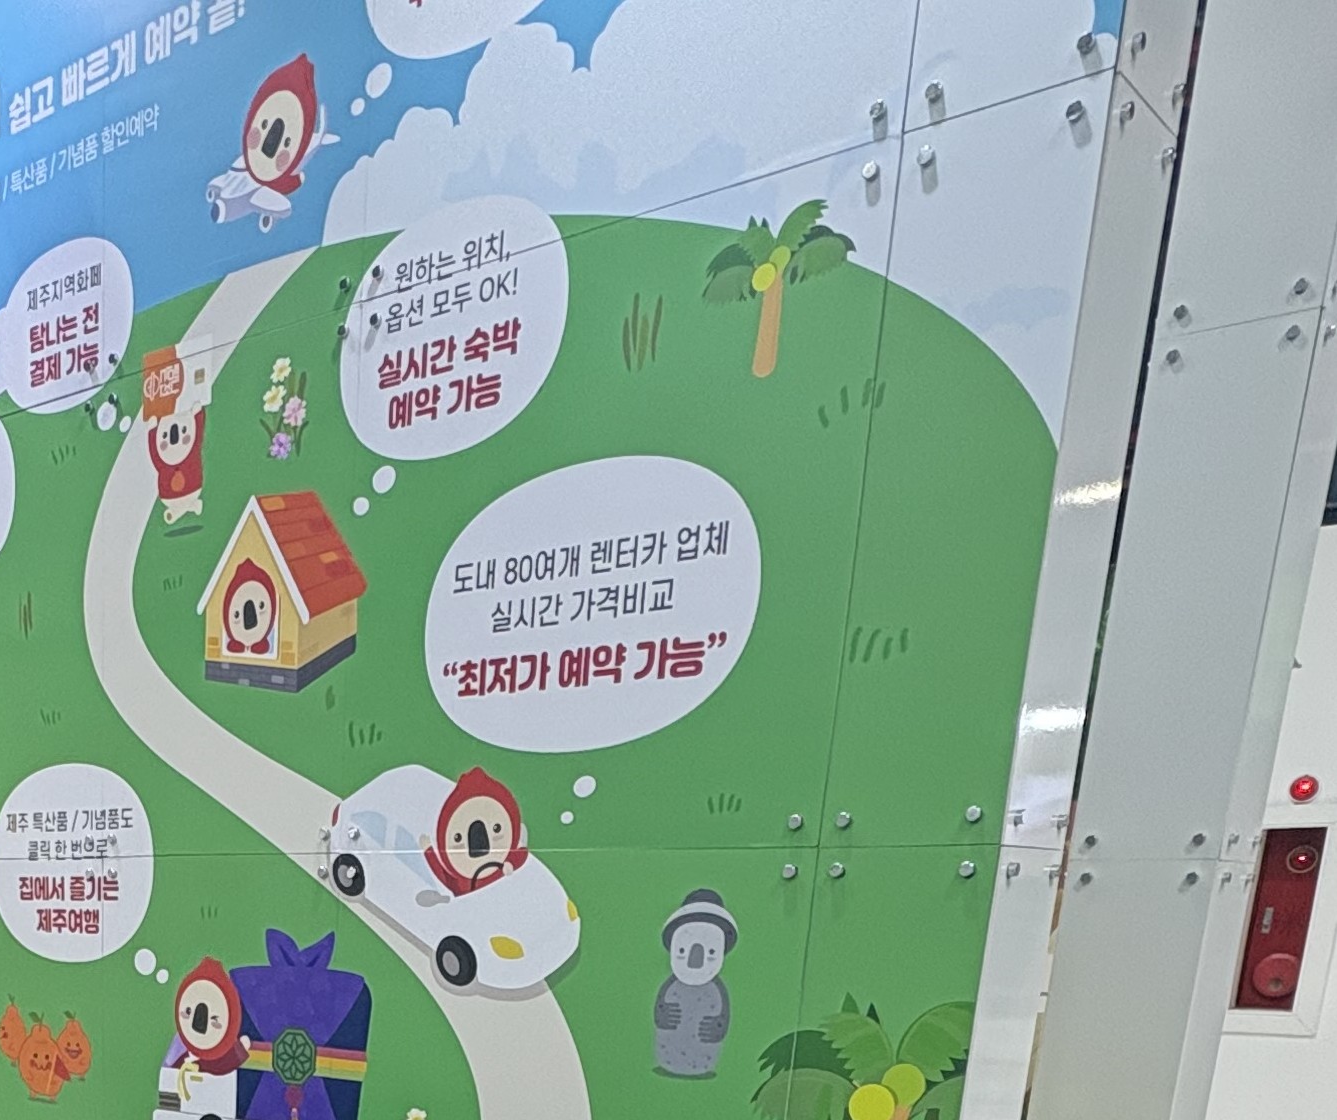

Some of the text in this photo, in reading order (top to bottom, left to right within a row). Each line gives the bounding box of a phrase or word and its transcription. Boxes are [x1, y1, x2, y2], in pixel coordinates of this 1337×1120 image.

[8, 75, 55, 135] 쉽고
[61, 29, 137, 107] 빠르게
[144, 0, 201, 65] 예약
[58, 132, 99, 171] 기념품
[101, 103, 160, 155] 할인예약
[395, 229, 511, 293] 원하는 위치,
[29, 302, 100, 354] 탐나는 전
[385, 267, 518, 334] 옵션 모두 OK!
[30, 343, 99, 388] 결제 가능
[377, 317, 522, 390] 실시간 숙박
[388, 373, 502, 430] 예약 가능
[452, 520, 730, 594] 도내 80여개 렌터카 업체
[491, 578, 675, 634] 실시간 가격비교
[558, 642, 628, 688] 예약
[6, 813, 29, 833] 제주
[33, 811, 68, 833] 특산품
[82, 808, 133, 830] 기념품도
[28, 840, 51, 861] 클릭
[55, 839, 67, 861] 한
[19, 875, 119, 901] 집에서 즐기는
[36, 909, 100, 934] 제주여행
